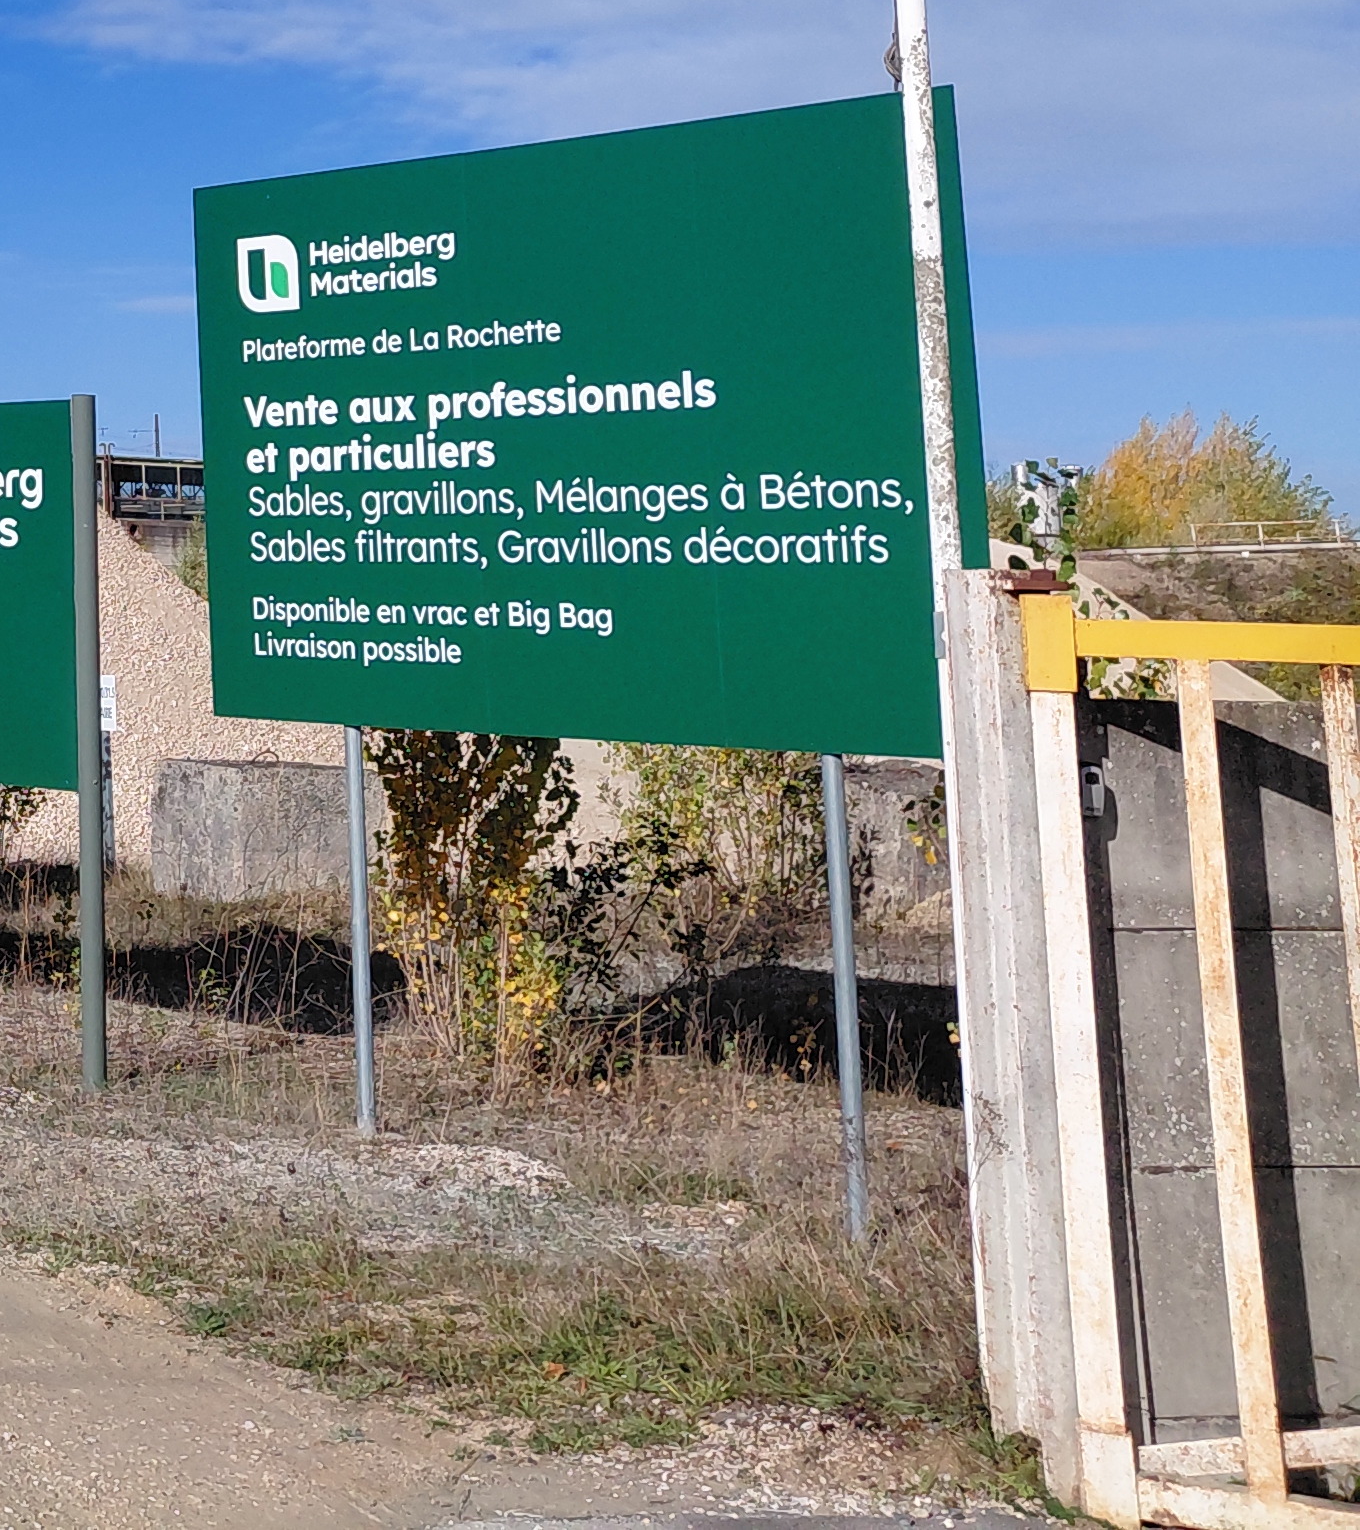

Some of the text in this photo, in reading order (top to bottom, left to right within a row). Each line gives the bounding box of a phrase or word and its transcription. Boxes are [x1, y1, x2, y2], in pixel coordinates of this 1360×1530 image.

[310, 232, 455, 260] Heidelberg
[311, 262, 437, 296] Materials
[243, 320, 561, 362] Plateforme de La Rochette
[244, 370, 716, 427] Vente aux professionnels
[247, 428, 495, 477] et particuliers
[249, 471, 913, 524] Sables, gravillons, Mélanges à Bétons,
[251, 525, 888, 569] Sables filtrants, Gravillons décoratifs
[253, 596, 612, 636] Disponible en vrac et Big Bag
[255, 631, 461, 666] Livraison possible
